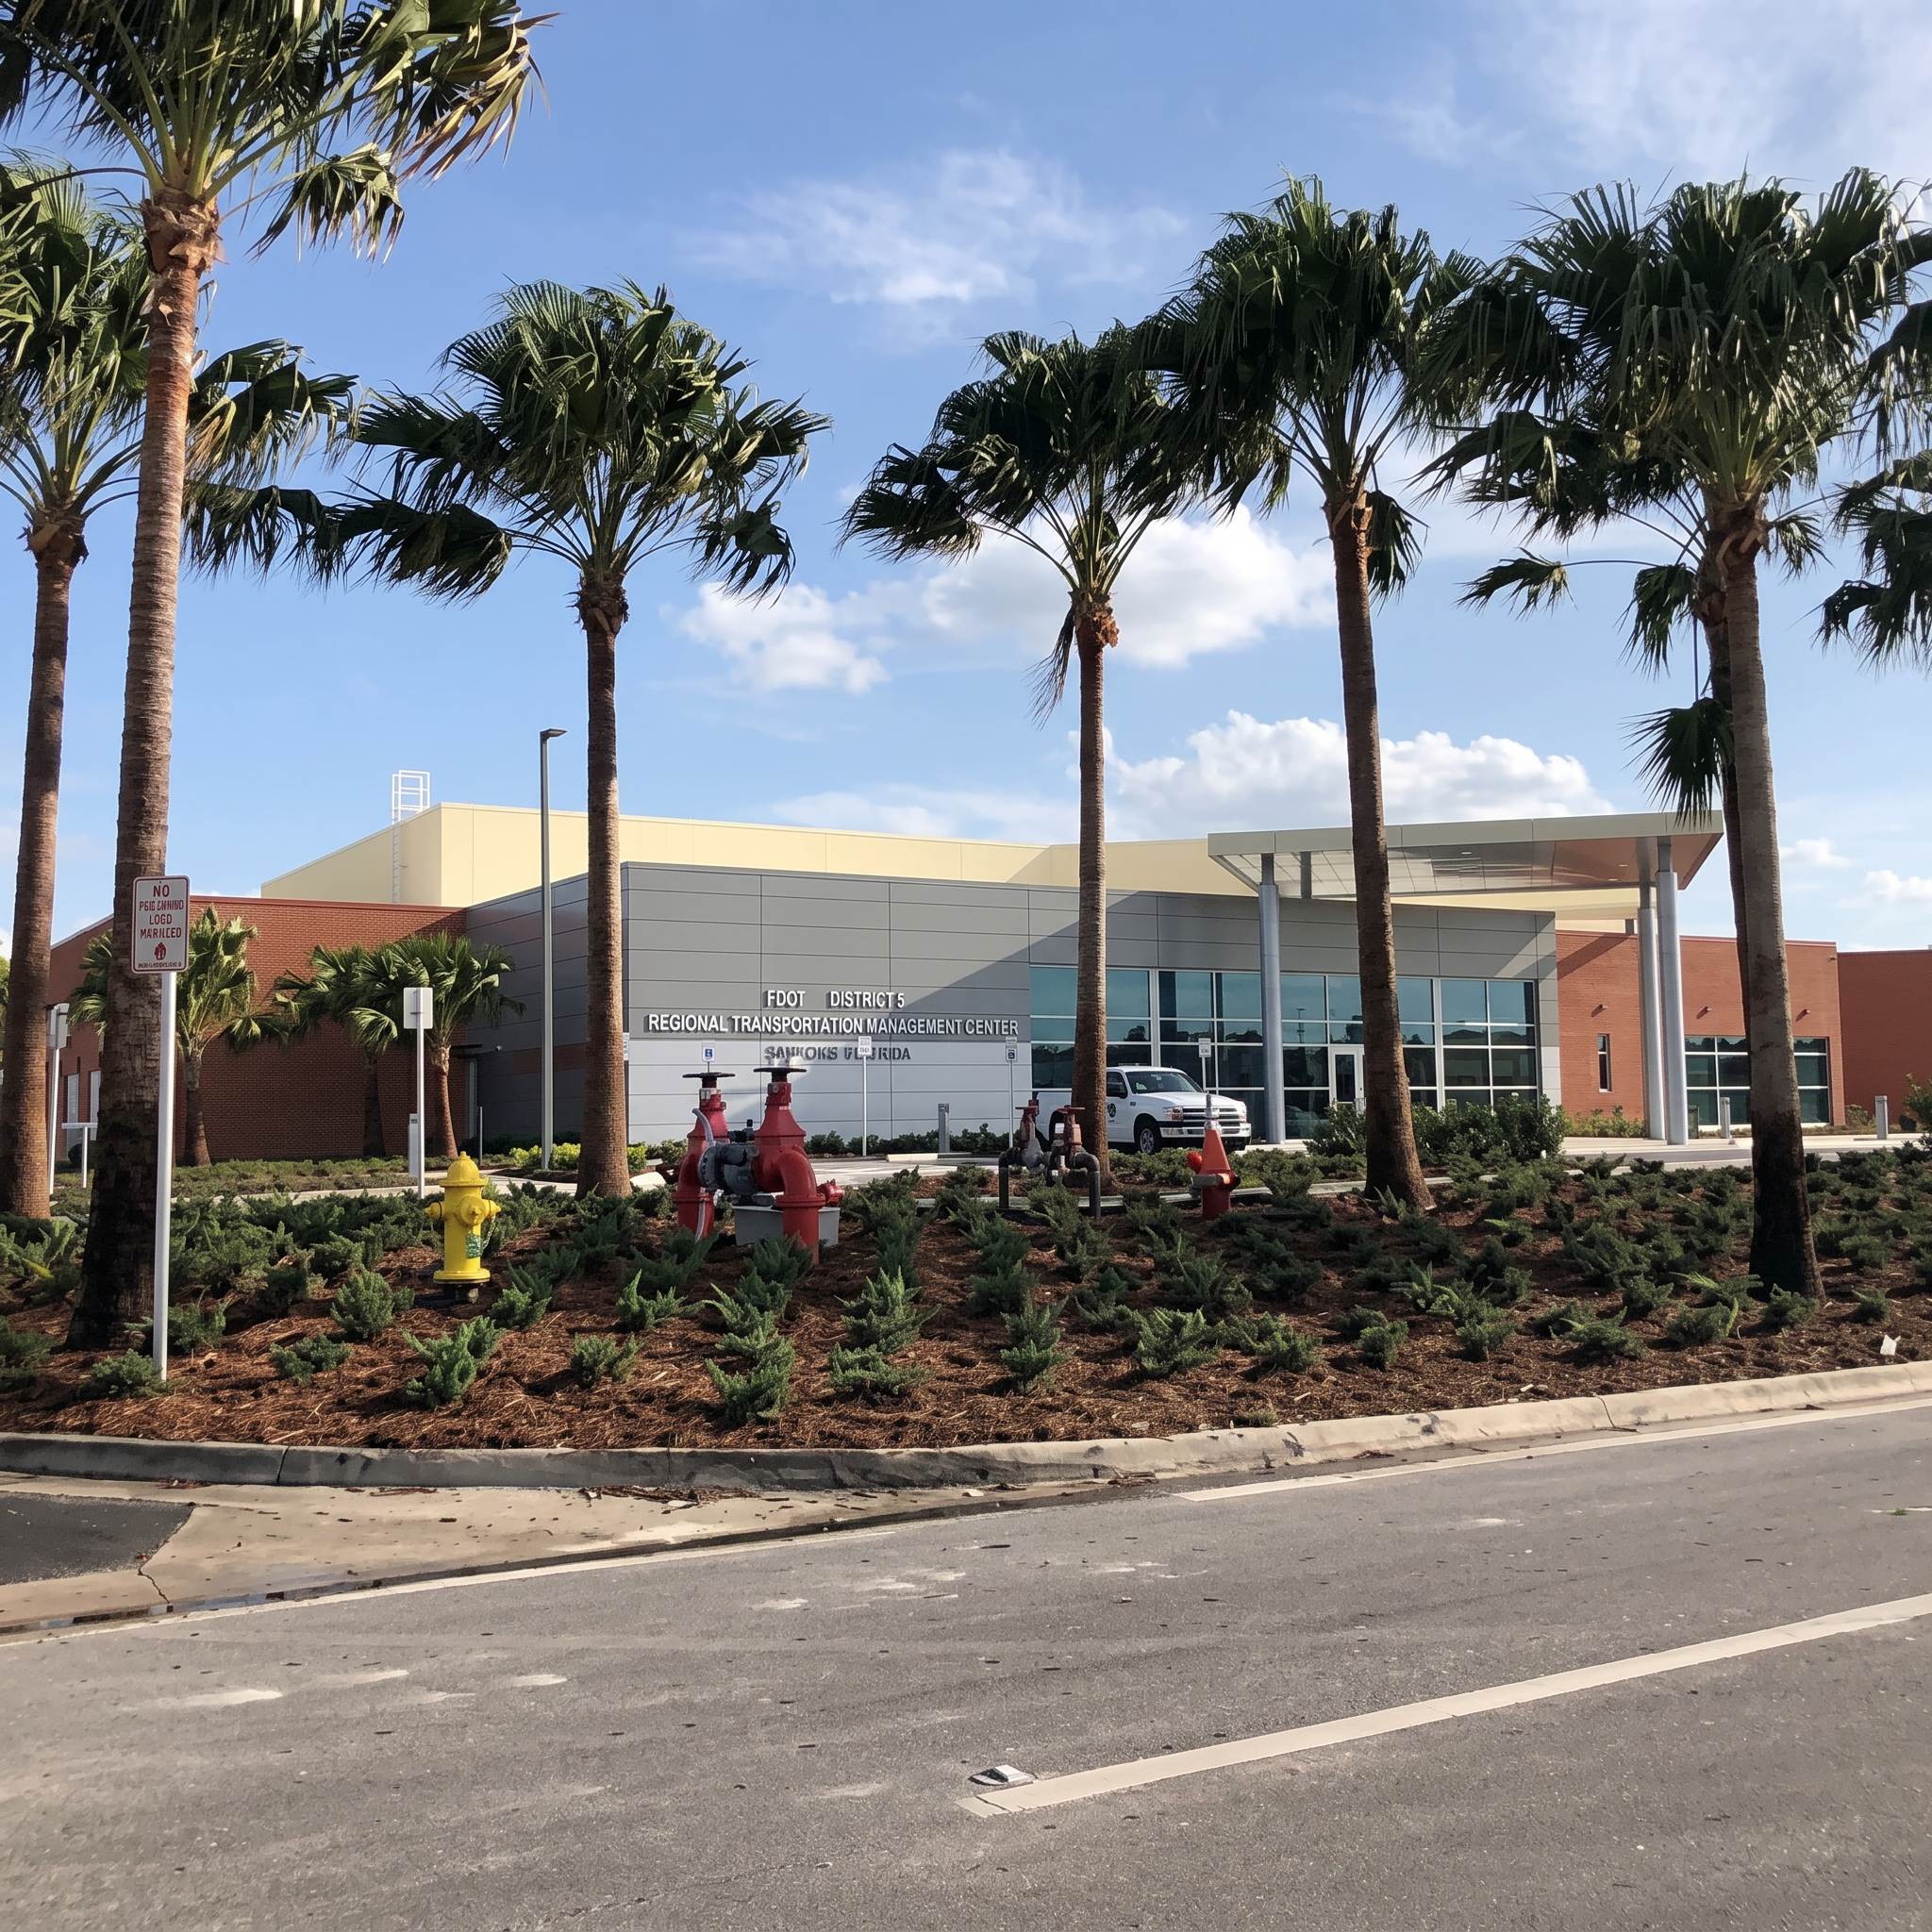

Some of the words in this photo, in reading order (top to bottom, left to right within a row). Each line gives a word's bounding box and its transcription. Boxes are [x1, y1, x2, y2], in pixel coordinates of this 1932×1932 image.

[153, 885, 170, 897] NO
[767, 990, 806, 1008] FDOT
[830, 991, 895, 1008] DISTRICT
[897, 992, 905, 1008] 5
[648, 1013, 728, 1032] REGIONAL
[731, 1015, 863, 1034] TRANSPORTATION
[866, 1018, 962, 1035] MANAGEMENT
[965, 1019, 1019, 1036] CENTER
